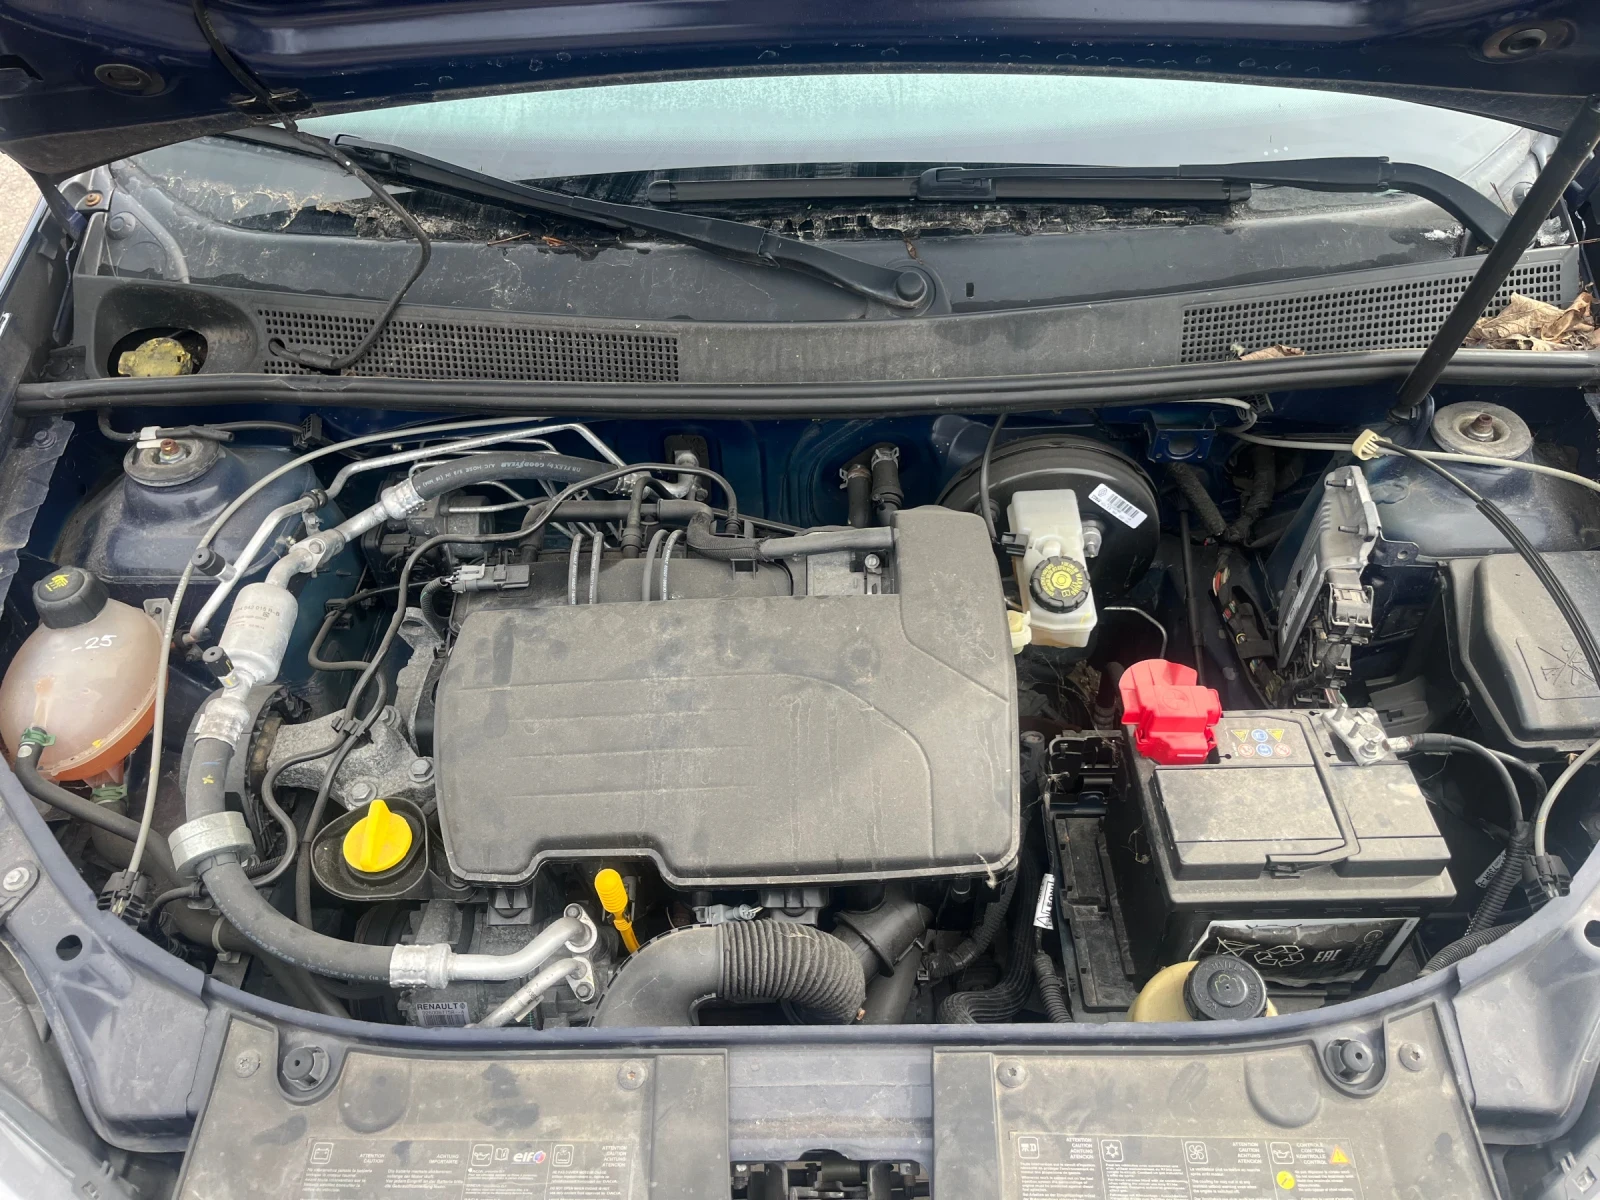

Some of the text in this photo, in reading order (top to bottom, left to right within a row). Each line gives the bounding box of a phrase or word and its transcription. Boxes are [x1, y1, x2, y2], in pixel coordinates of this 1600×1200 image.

[500, 460, 545, 469] GOODYEAR
[1313, 949, 1342, 962] EAC
[513, 1152, 534, 1162] elf
